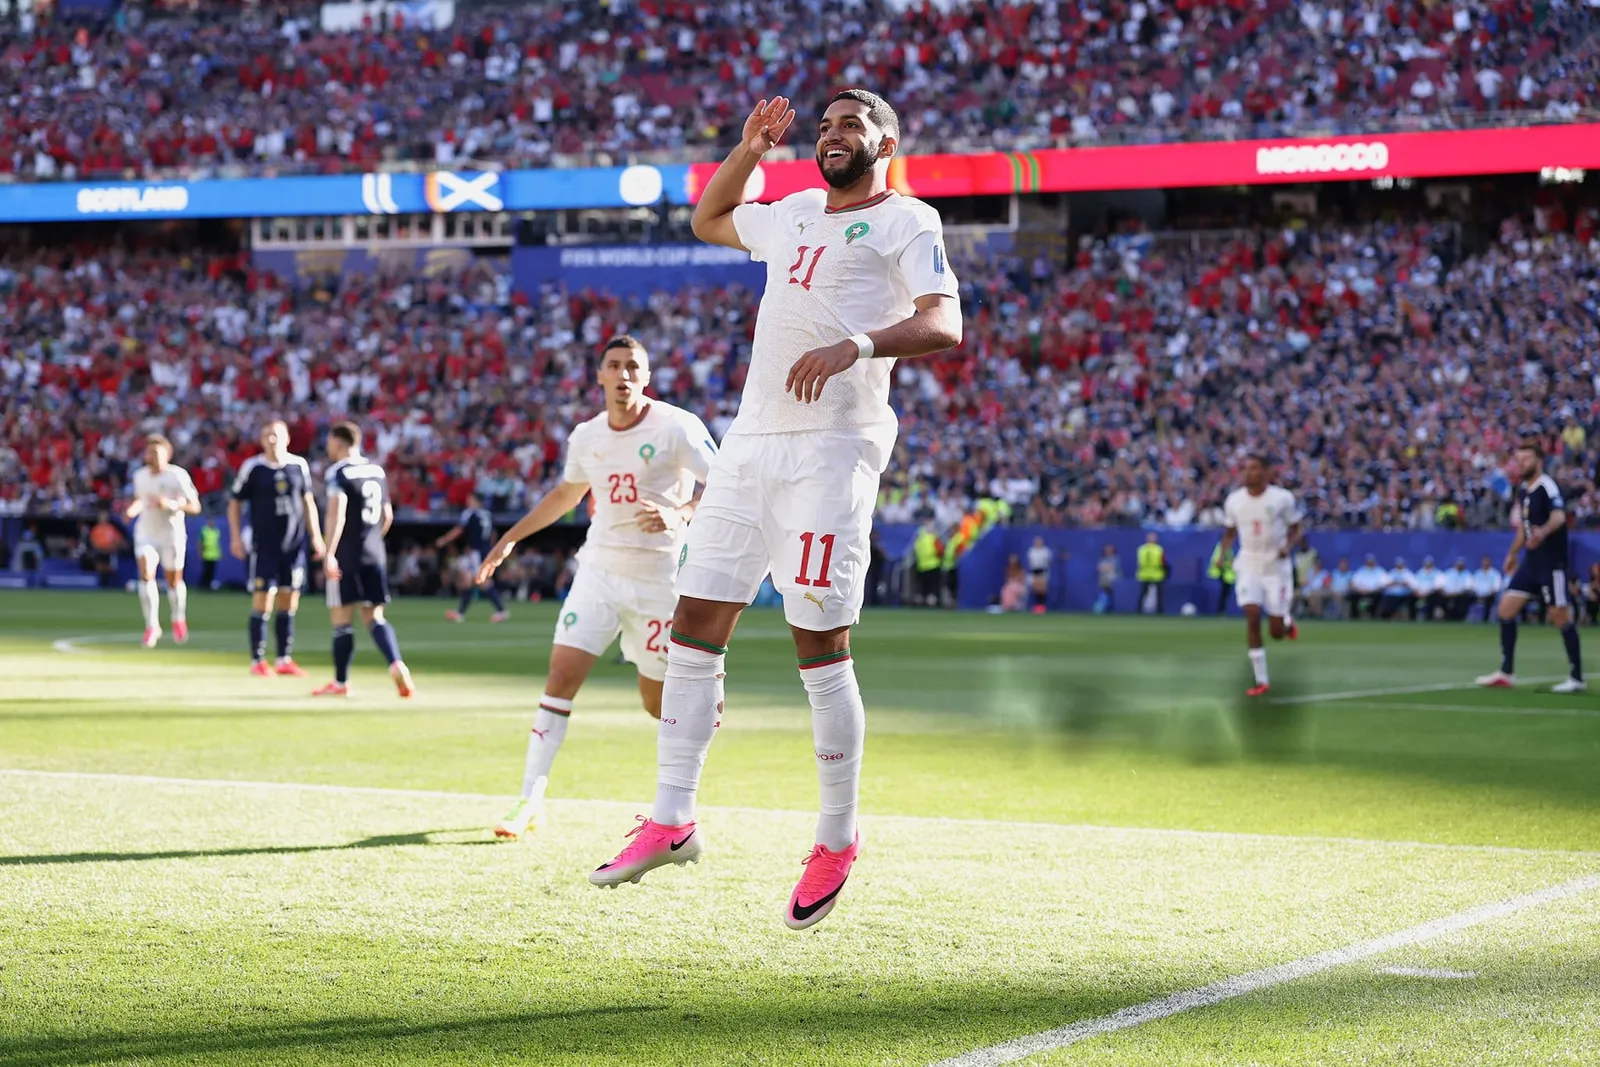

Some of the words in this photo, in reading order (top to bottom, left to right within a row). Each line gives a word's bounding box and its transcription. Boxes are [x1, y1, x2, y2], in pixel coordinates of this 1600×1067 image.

[1256, 142, 1388, 174] MOROCCO
[77, 186, 188, 213] SCOTLAND
[361, 480, 382, 525] 3
[608, 473, 638, 503] 23
[795, 531, 836, 587] 11
